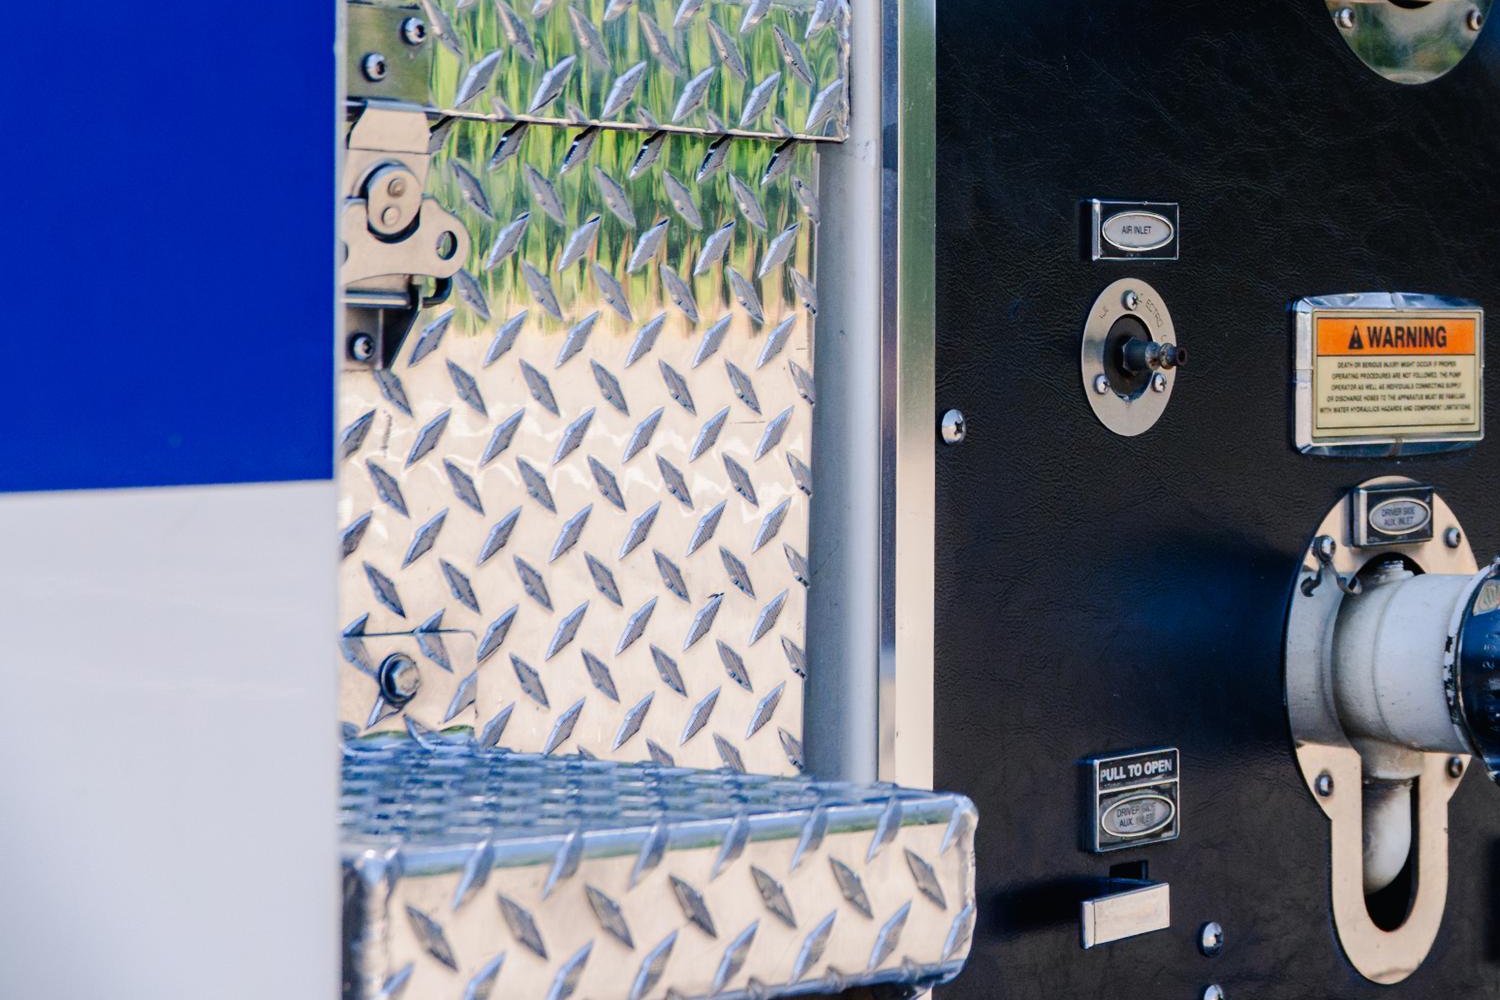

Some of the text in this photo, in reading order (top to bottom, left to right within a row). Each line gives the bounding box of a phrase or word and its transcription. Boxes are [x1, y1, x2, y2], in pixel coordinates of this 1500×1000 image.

[1122, 225, 1152, 234] AIR INLET
[1367, 325, 1447, 348] WARNING
[1100, 759, 1172, 781] PULL TO OPEN
[1116, 807, 1140, 818] DRIVER
